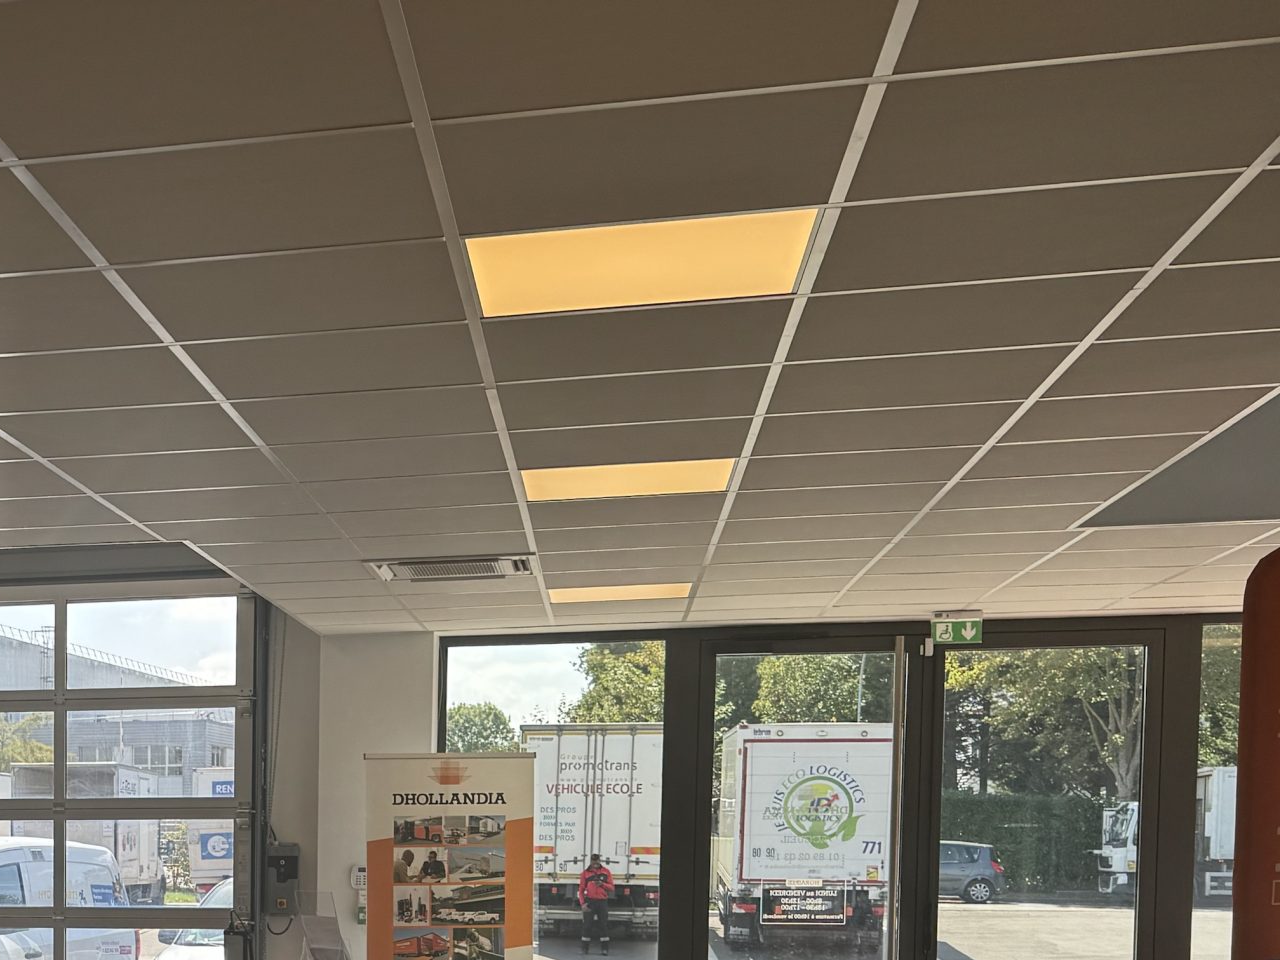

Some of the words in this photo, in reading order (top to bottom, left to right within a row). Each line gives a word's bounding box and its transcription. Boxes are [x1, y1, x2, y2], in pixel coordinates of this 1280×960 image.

[560, 759, 638, 774] promotrans
[546, 783, 604, 795] VEHICULE
[606, 783, 643, 794] ECOLE
[781, 768, 806, 789] ECO
[809, 764, 866, 804] LOGISTICS
[392, 792, 507, 806] DHOLLANDIA
[862, 841, 882, 855] 771
